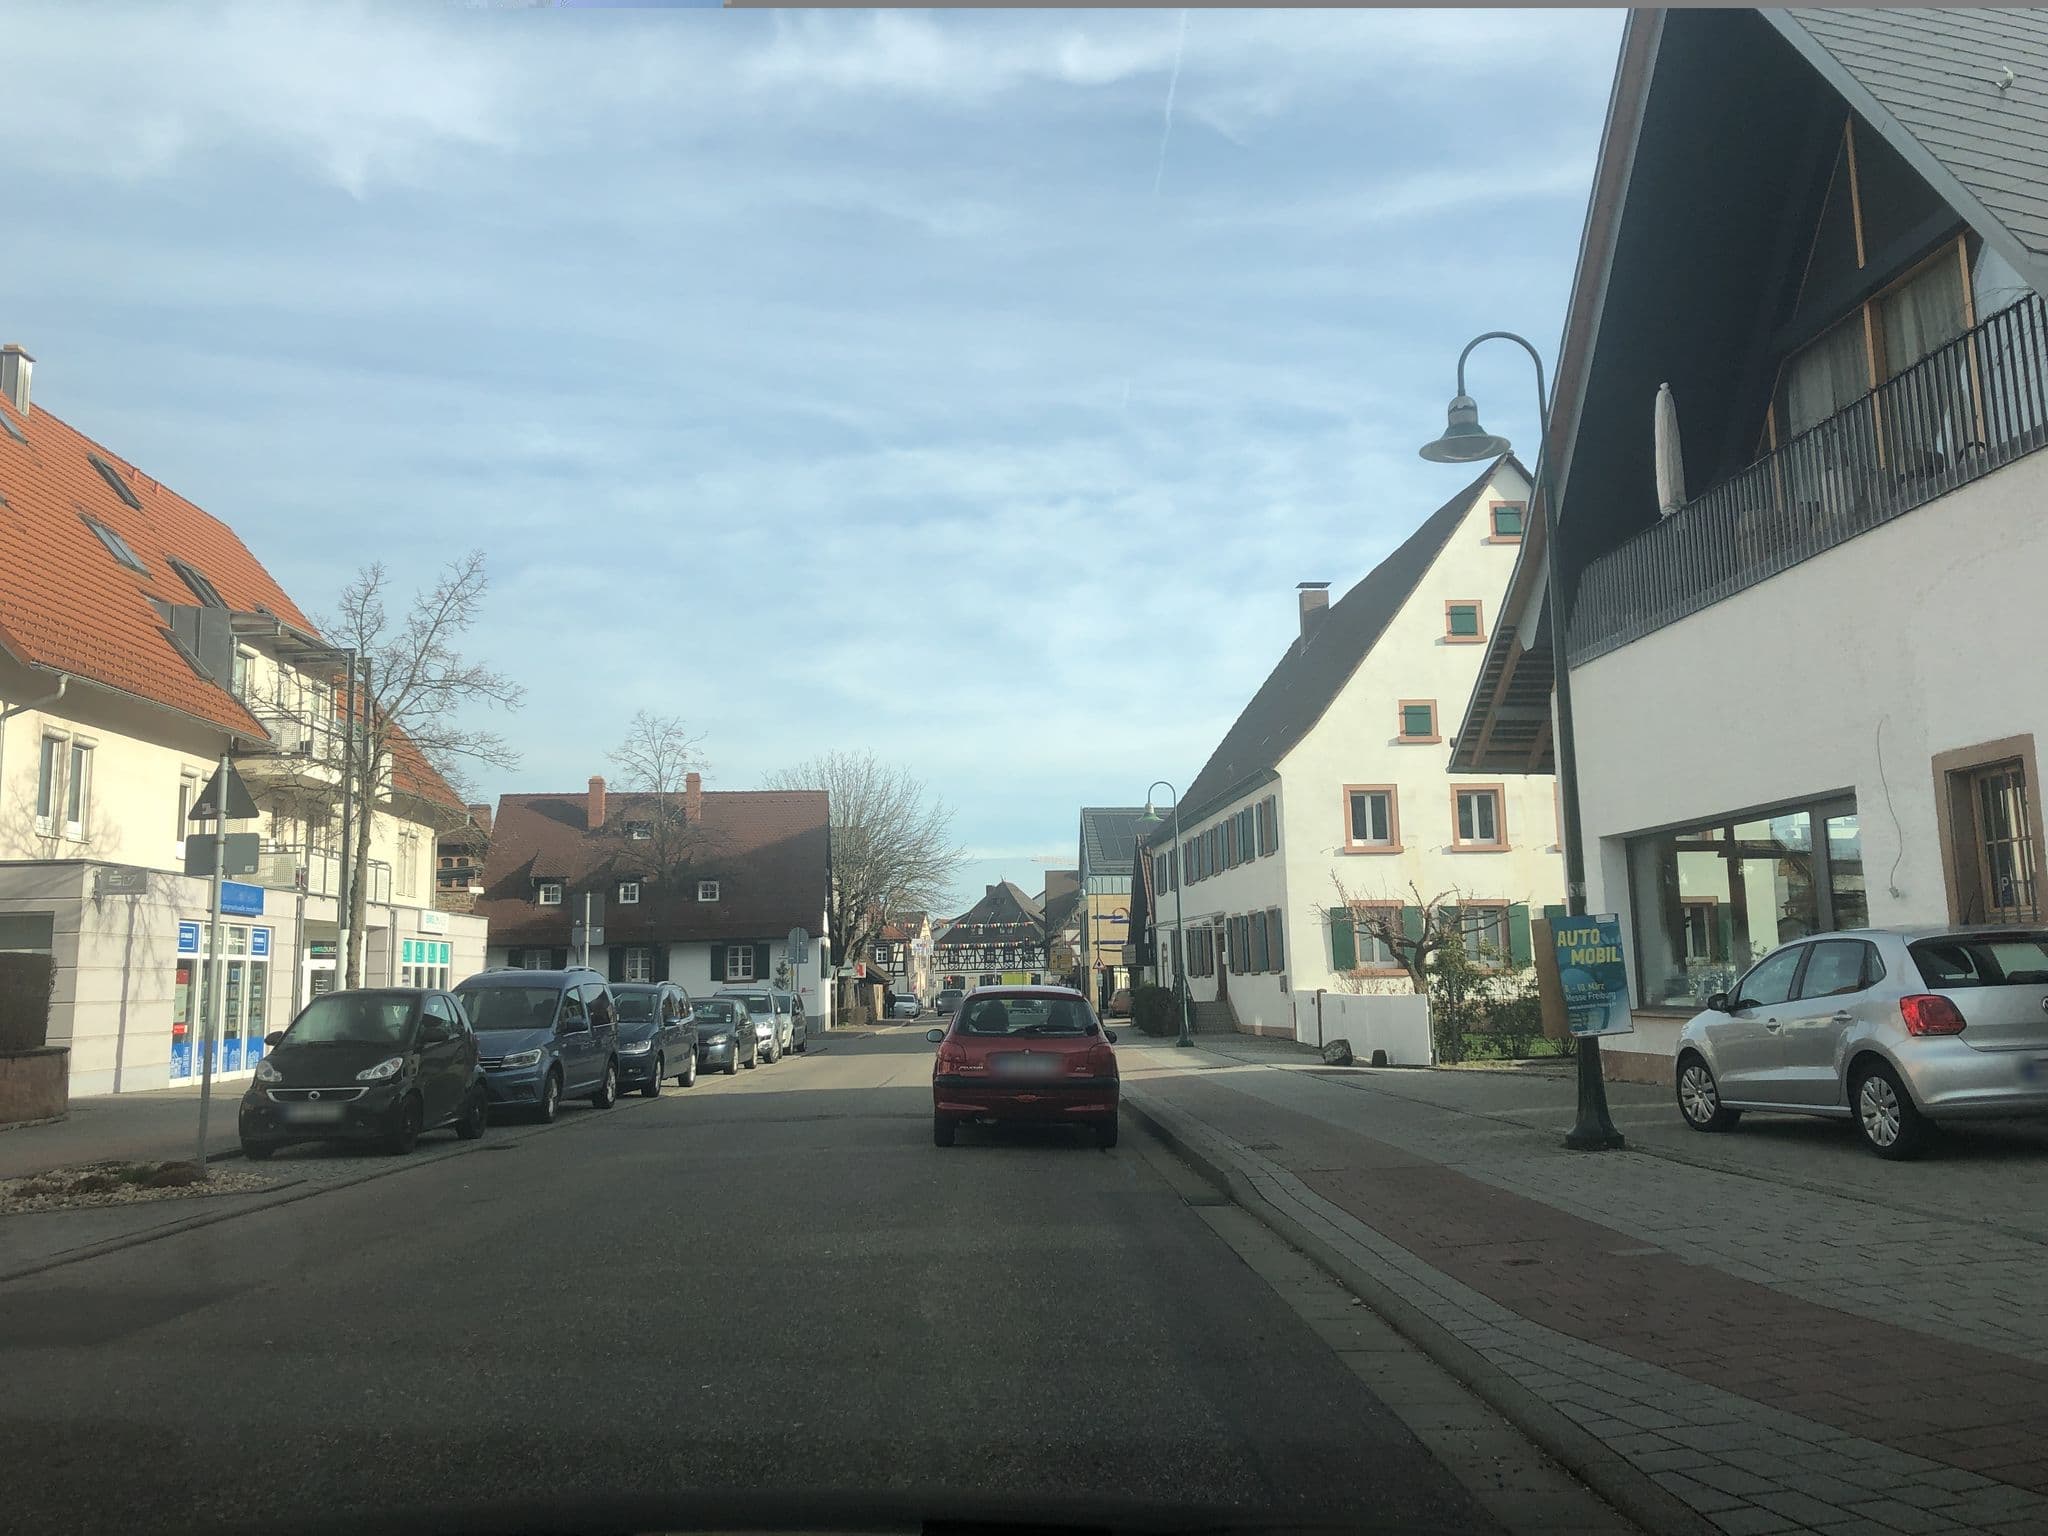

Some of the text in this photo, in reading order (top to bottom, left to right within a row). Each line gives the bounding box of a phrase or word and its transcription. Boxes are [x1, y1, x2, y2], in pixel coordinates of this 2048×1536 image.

[1558, 928, 1600, 947] AUTO
[1571, 946, 1621, 965] MOBIL
[1588, 991, 1616, 1001] Freiburg
